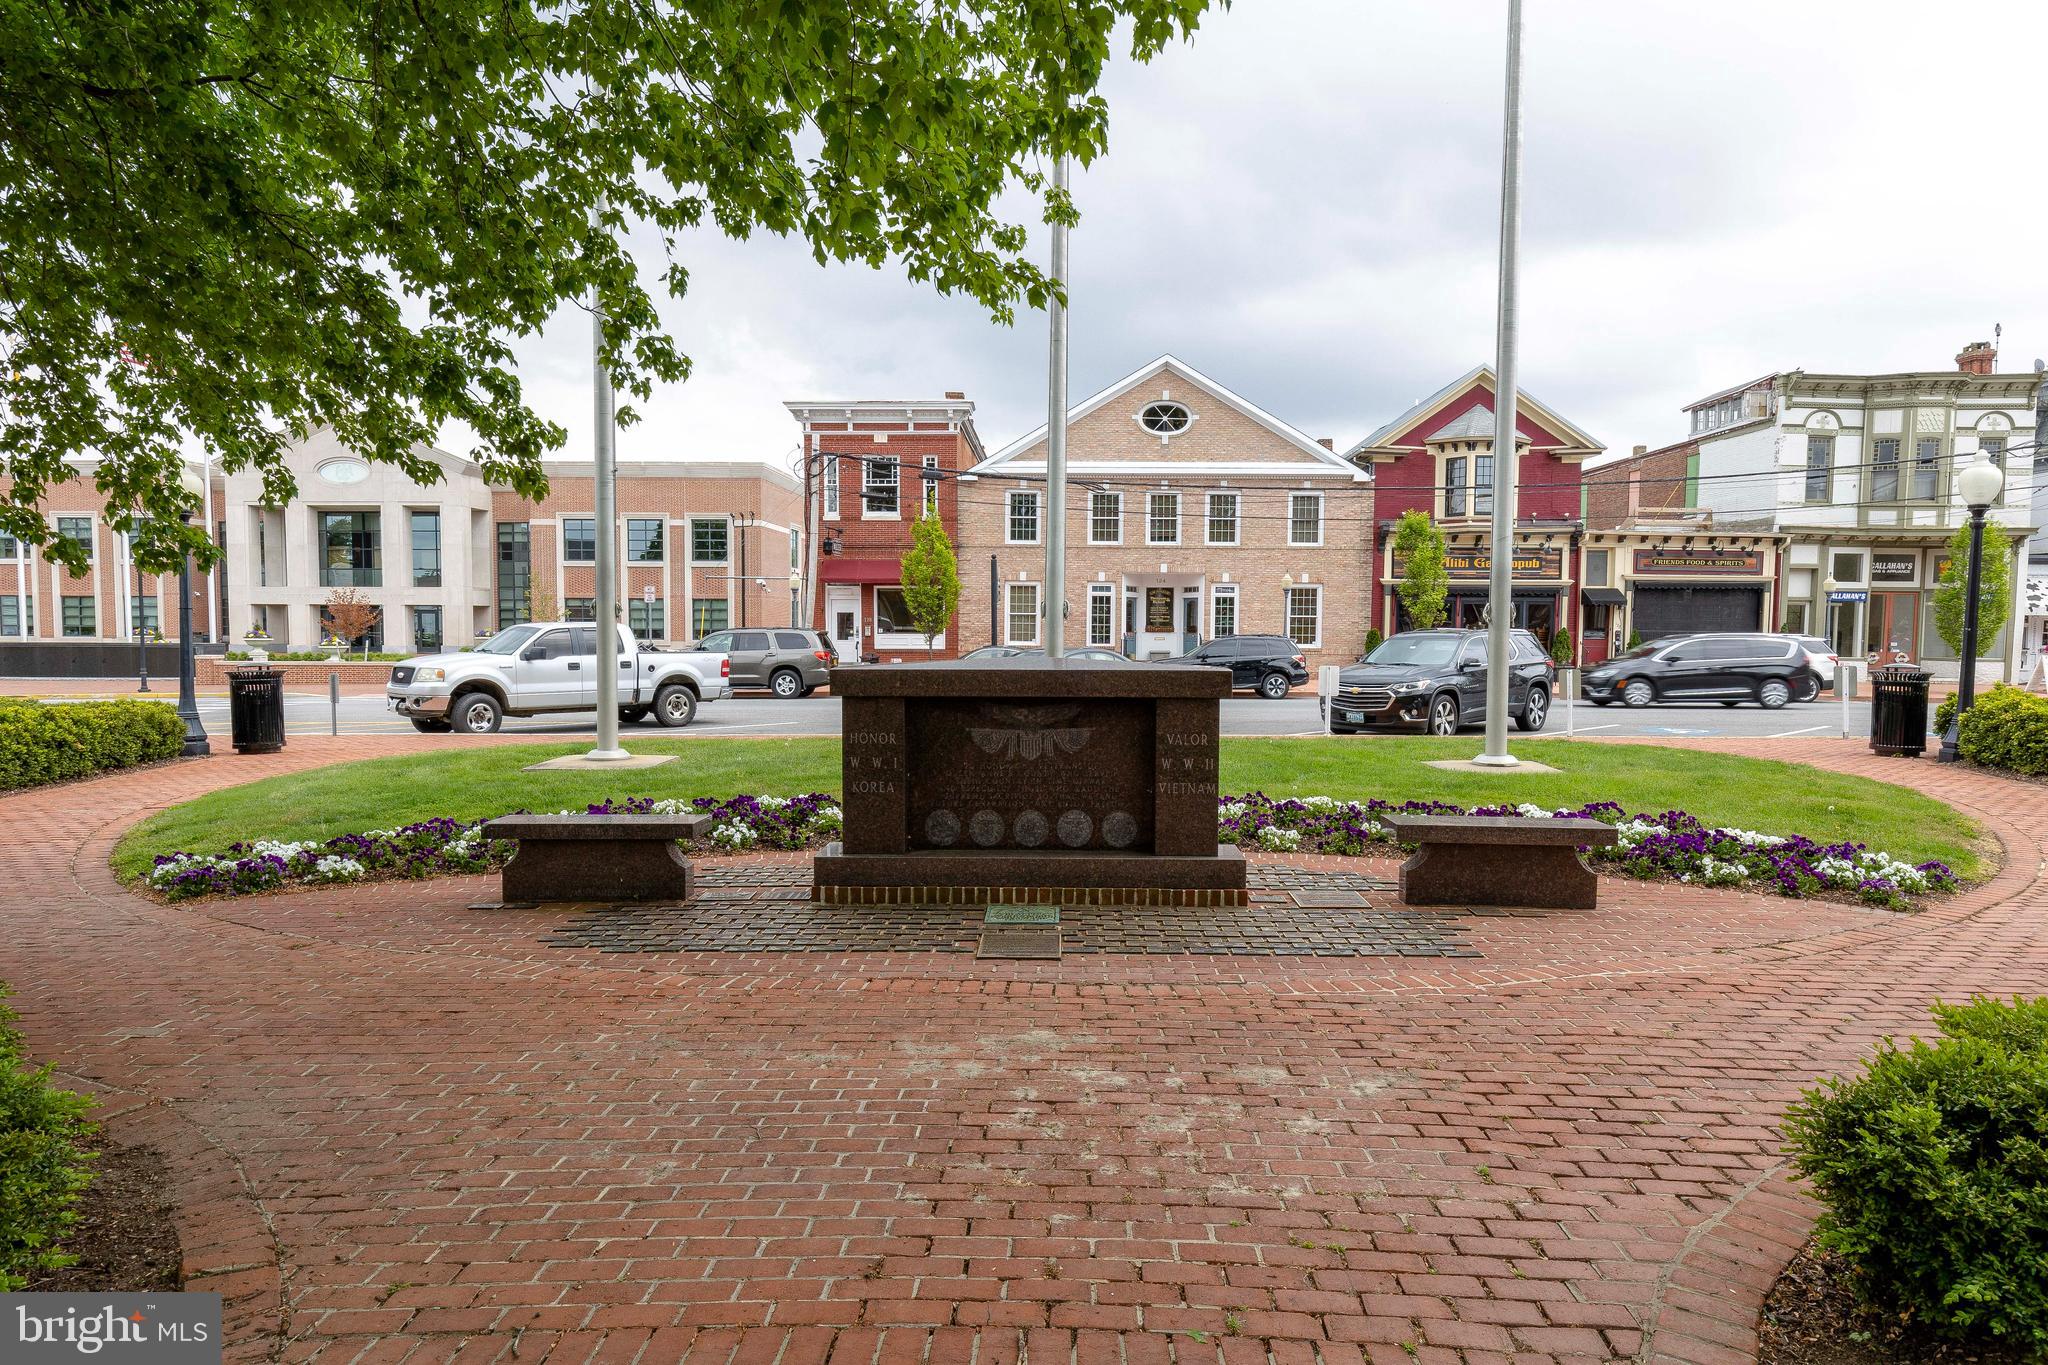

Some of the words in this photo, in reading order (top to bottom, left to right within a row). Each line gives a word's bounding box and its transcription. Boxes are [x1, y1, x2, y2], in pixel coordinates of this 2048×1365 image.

[1473, 557, 1540, 570] Gaopub
[1829, 592, 1867, 600] ALLAHAN'S
[850, 732, 897, 745] HONOR
[1166, 733, 1208, 745] VALOR
[852, 781, 895, 793] KOREA
[1159, 782, 1216, 794] VIETNAM
